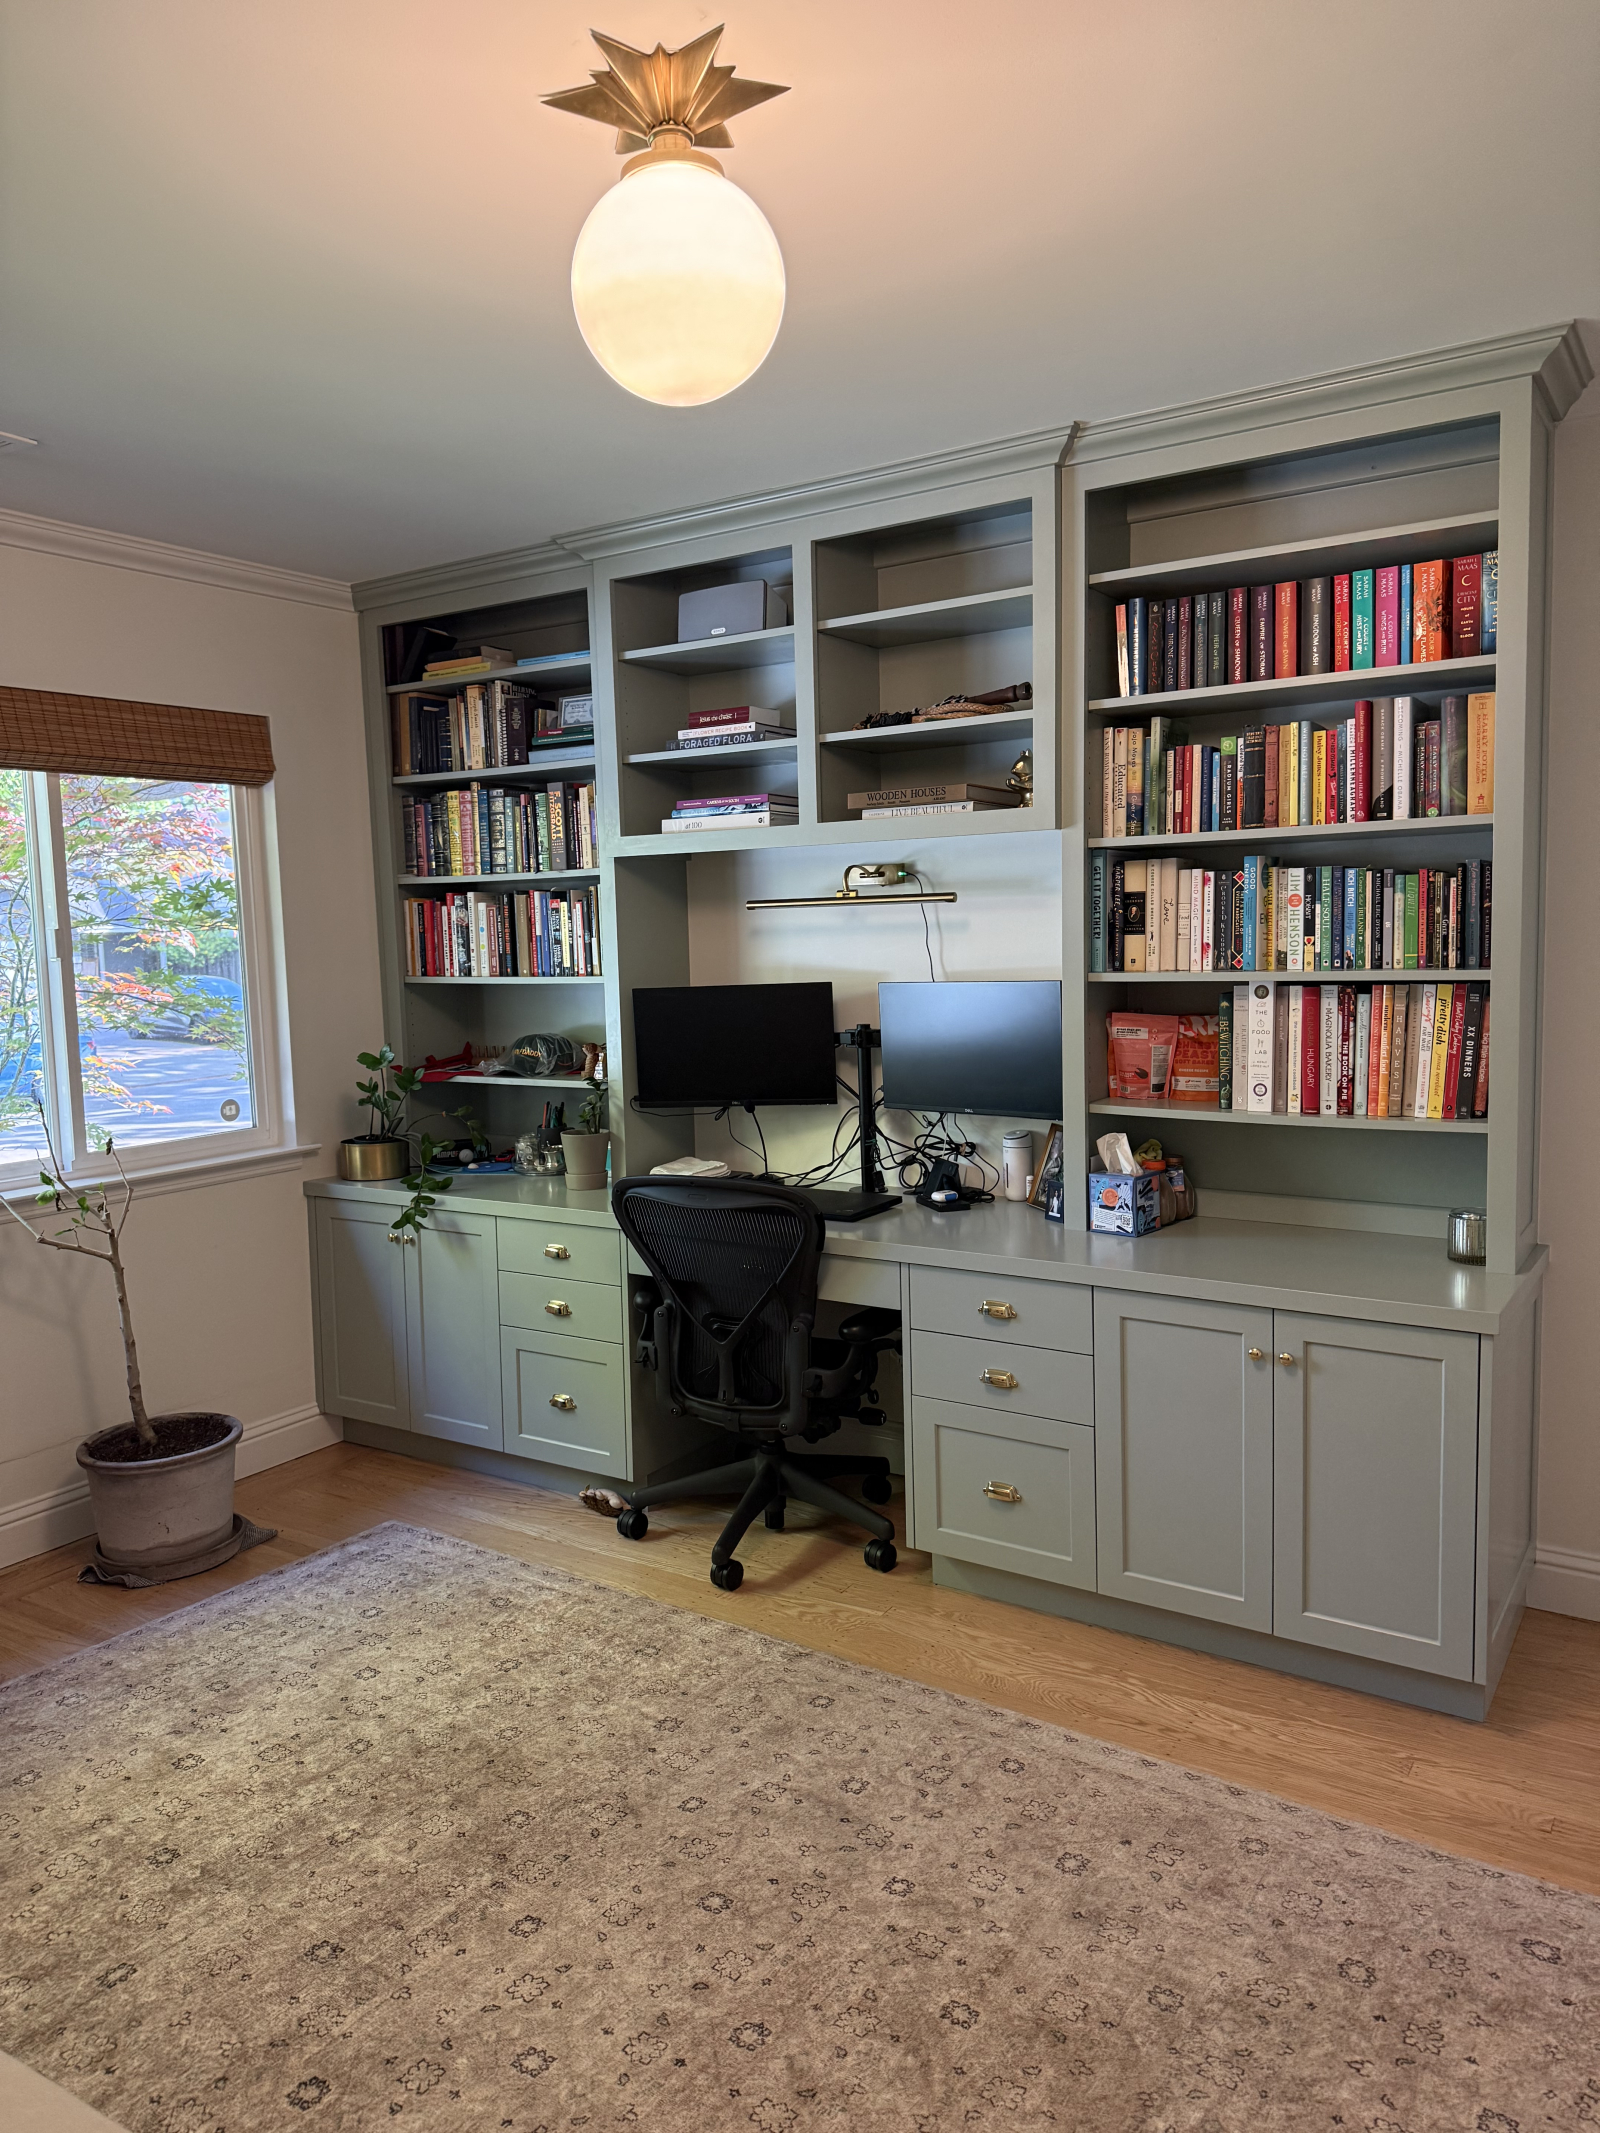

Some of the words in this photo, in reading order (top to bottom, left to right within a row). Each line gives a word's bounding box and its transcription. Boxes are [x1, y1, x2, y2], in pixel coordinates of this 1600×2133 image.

[1457, 563, 1478, 572] MAAS
[1457, 595, 1478, 604] CITY
[1234, 616, 1242, 639] QUEEN
[1234, 648, 1242, 680] SHADOWS
[699, 716, 711, 724] Jesus
[719, 713, 733, 721] Christ
[679, 737, 721, 750] FORAGED
[722, 733, 753, 745] FLORA
[695, 728, 714, 736] FLOWER
[1131, 731, 1139, 746] Jojo
[1131, 747, 1139, 768] Moyes
[554, 791, 561, 800] F.
[867, 790, 907, 802] WOODEN
[910, 786, 947, 799] HOUSES
[1118, 764, 1126, 809] Educated
[548, 791, 557, 840] FITZGERALD
[554, 802, 563, 839] SCOTT
[891, 807, 909, 817] LIVE
[910, 804, 955, 816] BEAUTIFUL
[691, 821, 703, 829] 100
[1130, 820, 1138, 835] Stars
[1093, 866, 1101, 882] GET
[1290, 872, 1301, 892] JIM
[1347, 869, 1355, 886] RICH
[1093, 884, 1101, 894] IT
[1323, 879, 1331, 904] HALF
[1347, 887, 1355, 907] BITCH
[1093, 896, 1102, 940] TOGETHER!
[1163, 898, 1174, 926] Love
[1322, 907, 1331, 931] SOUL
[1290, 909, 1301, 956] HENSON
[1442, 919, 1450, 936] GIVER
[1383, 1004, 1391, 1030] modern
[1421, 990, 1434, 1028] Cravings
[1439, 998, 1449, 1025] pretty
[1307, 1006, 1315, 1047] CULINARIA
[1325, 1007, 1334, 1049] MAGNOLIA
[1435, 1026, 1446, 1045] dish
[1467, 1026, 1476, 1037] XX
[1177, 1041, 1218, 1050] CHEESY
[1219, 1021, 1230, 1081] BEWITCHING
[1381, 1030, 1389, 1057] comfort
[1393, 1015, 1403, 1090] HARVEST
[1175, 1050, 1218, 1060] PEASY
[1463, 1040, 1474, 1078] DINNERS
[1306, 1048, 1315, 1088] HUNGARY
[1324, 1051, 1332, 1082] BAKERY
[1380, 1059, 1388, 1074] food
[1478, 1058, 1487, 1083] recipes
[1341, 1077, 1348, 1087] ON
